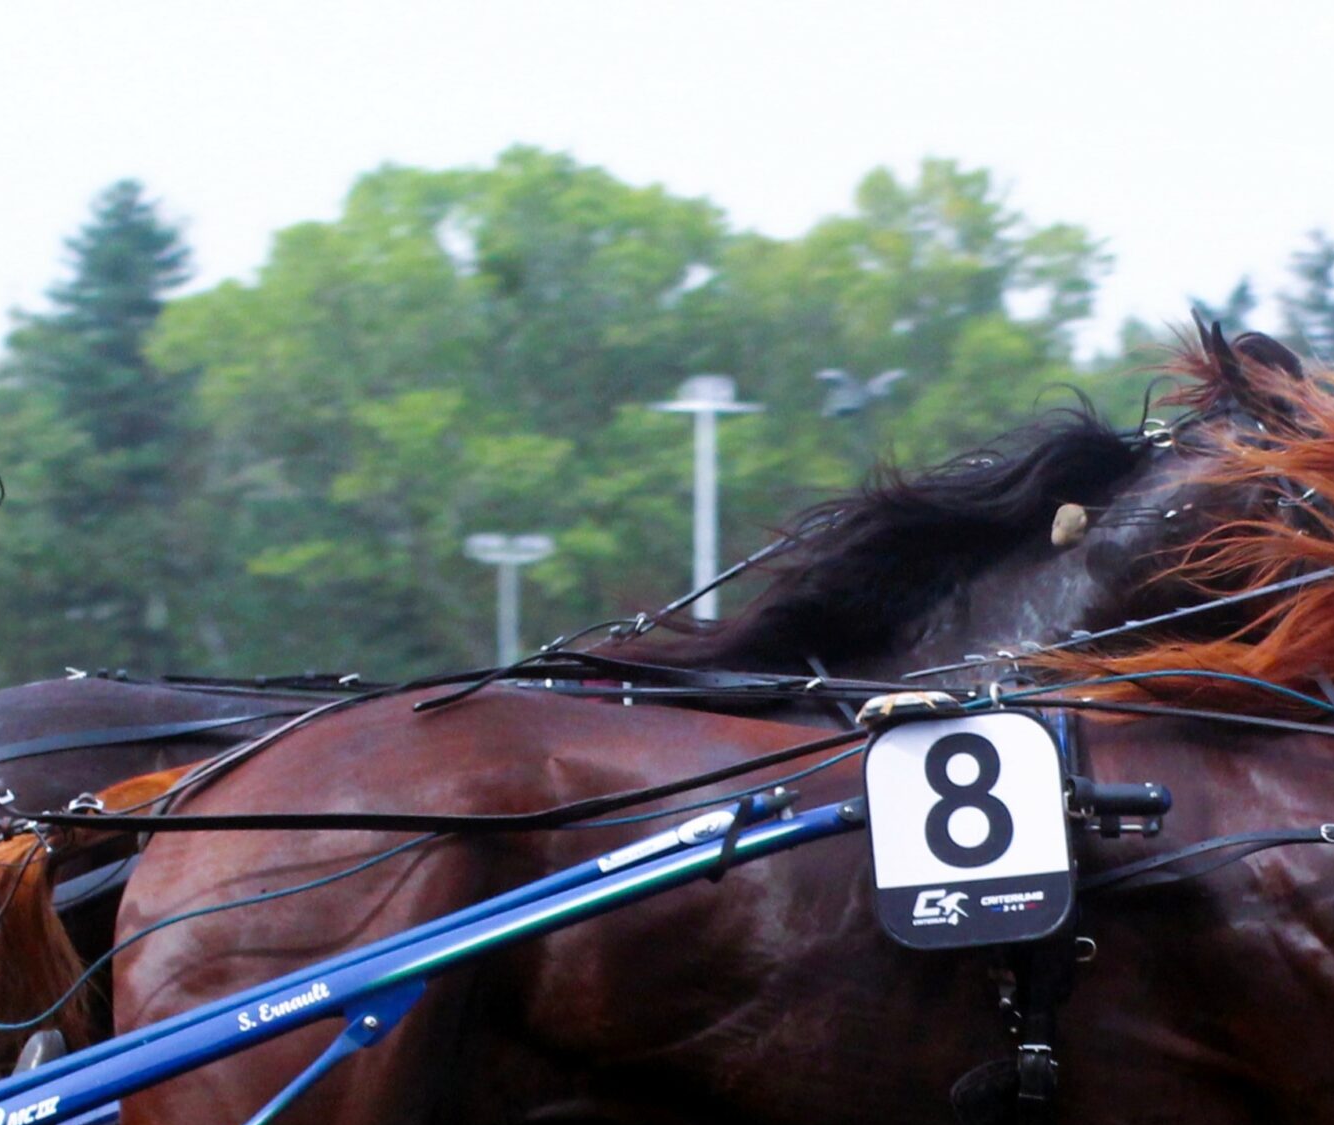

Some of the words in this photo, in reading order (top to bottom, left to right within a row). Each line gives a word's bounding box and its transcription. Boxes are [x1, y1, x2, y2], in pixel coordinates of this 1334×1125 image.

[923, 731, 1015, 870] 8
[238, 1012, 257, 1031] S.
[258, 983, 330, 1022] Ernault
